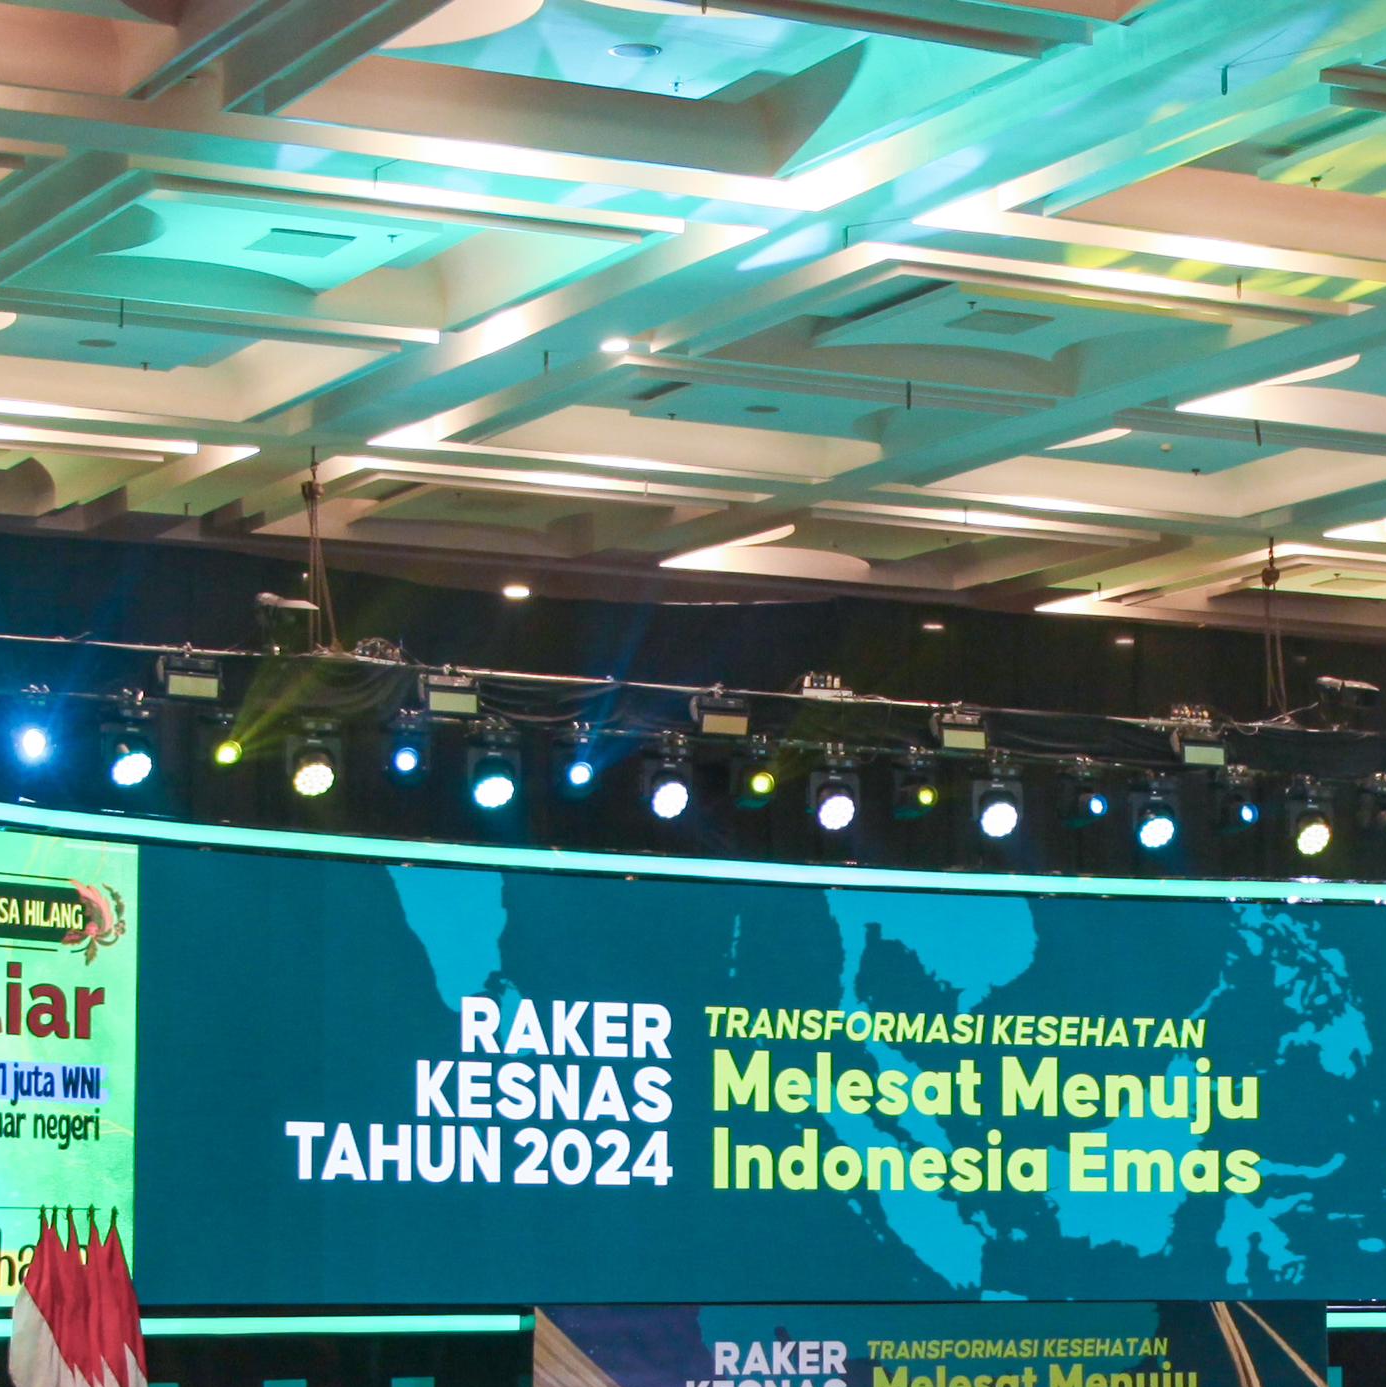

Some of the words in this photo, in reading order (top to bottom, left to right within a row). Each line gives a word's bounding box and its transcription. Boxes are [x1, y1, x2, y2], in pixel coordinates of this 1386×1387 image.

[24, 902, 83, 929] HILANG
[460, 997, 674, 1060] RAKER
[705, 1006, 985, 1044] TRANSFORMASI
[989, 1015, 1205, 1049] KESEHATAN
[62, 1067, 101, 1098] WNI
[416, 1060, 674, 1123] KESNAS
[713, 1051, 981, 1118] Melesat
[1001, 1058, 1261, 1134] Menuju
[33, 1109, 100, 1149] negeri
[285, 1122, 500, 1185] TAHUN
[514, 1127, 674, 1187] 2024
[713, 1127, 1049, 1192] Indonesia
[1068, 1134, 1262, 1195] Emas
[714, 1342, 848, 1374] RAKER
[866, 1340, 1042, 1360] TRANSFORMASI
[1043, 1337, 1168, 1357] KESEHATAN
